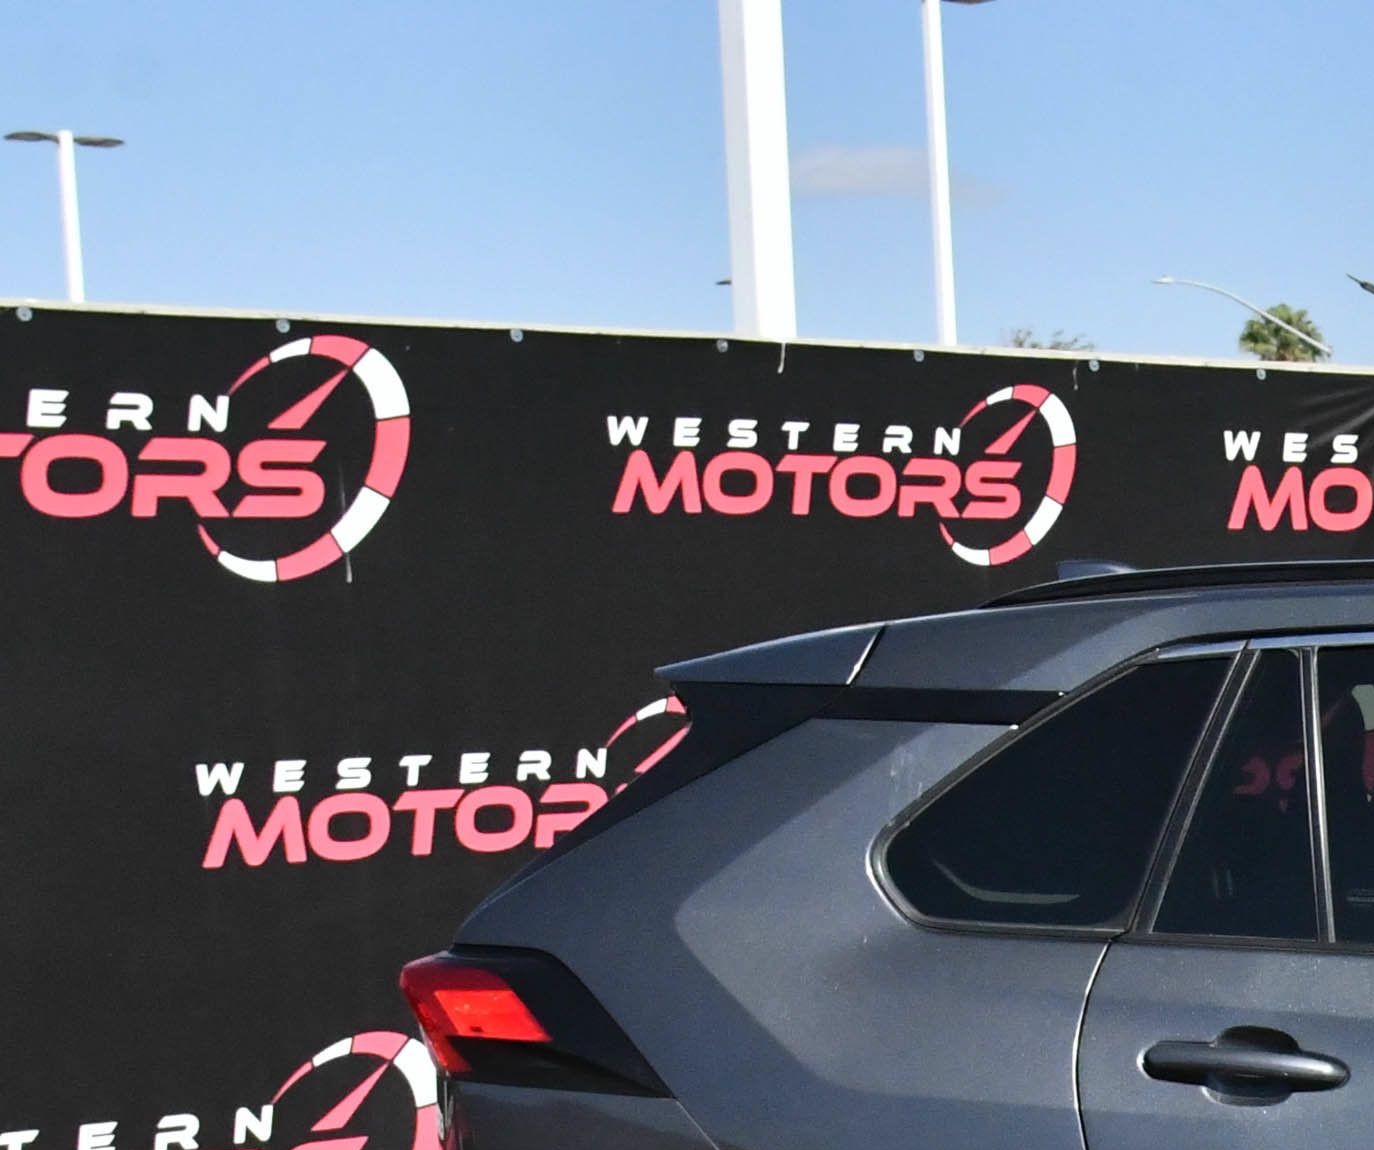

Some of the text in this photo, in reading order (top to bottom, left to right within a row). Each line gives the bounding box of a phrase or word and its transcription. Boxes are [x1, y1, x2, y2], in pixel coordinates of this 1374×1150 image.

[606, 415, 961, 456] WESTERN
[612, 449, 1023, 520] MOTORS
[195, 747, 608, 797] WESTERN
[202, 782, 627, 869] MOTOR
